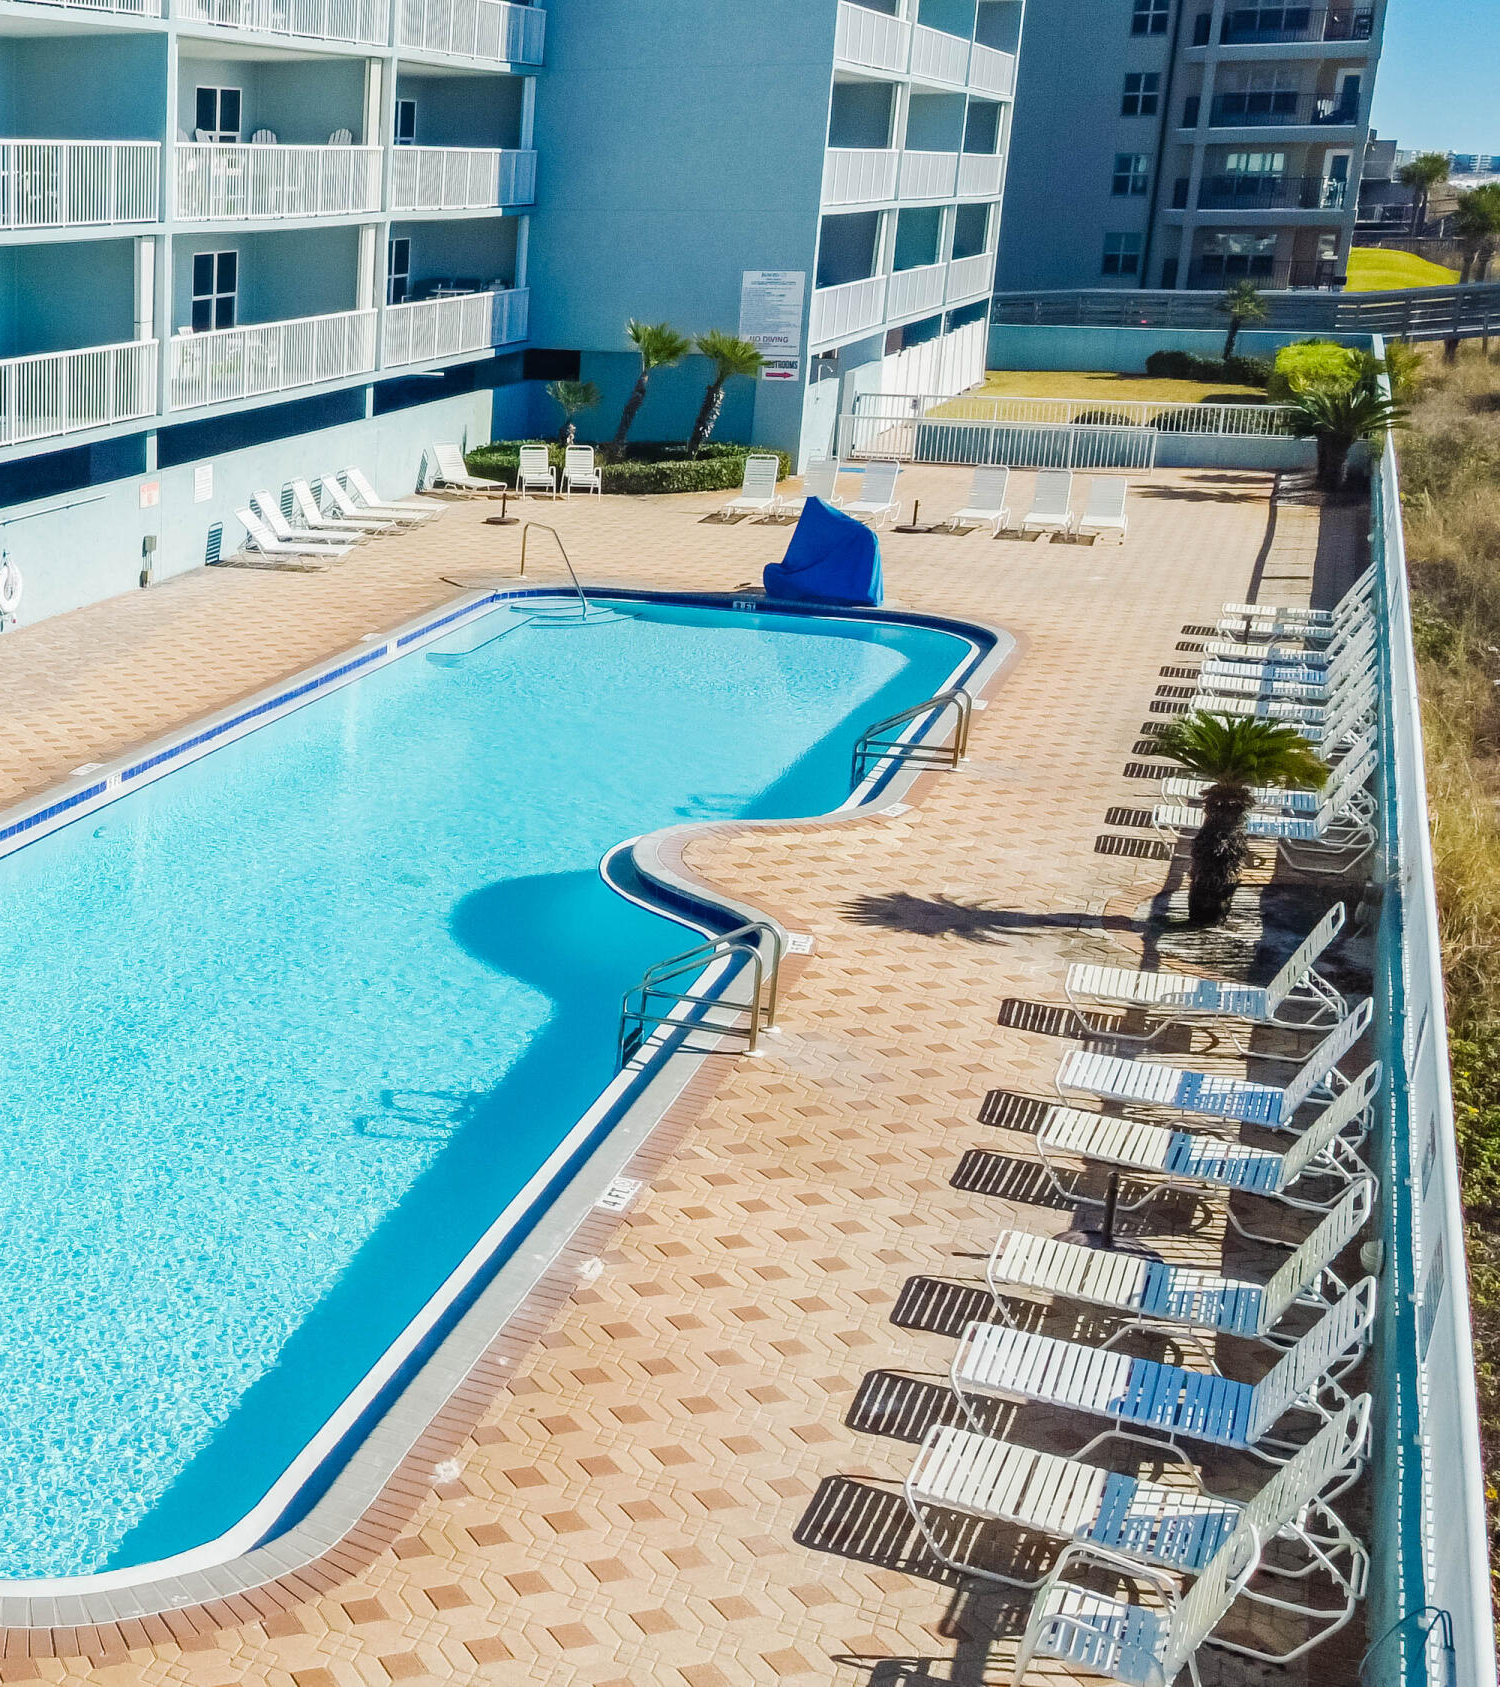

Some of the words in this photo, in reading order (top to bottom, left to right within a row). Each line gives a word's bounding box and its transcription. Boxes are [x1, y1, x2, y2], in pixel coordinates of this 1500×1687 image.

[762, 335, 789, 343] DIVING
[606, 1187, 631, 1200] FT
[602, 1199, 621, 1207] 4
